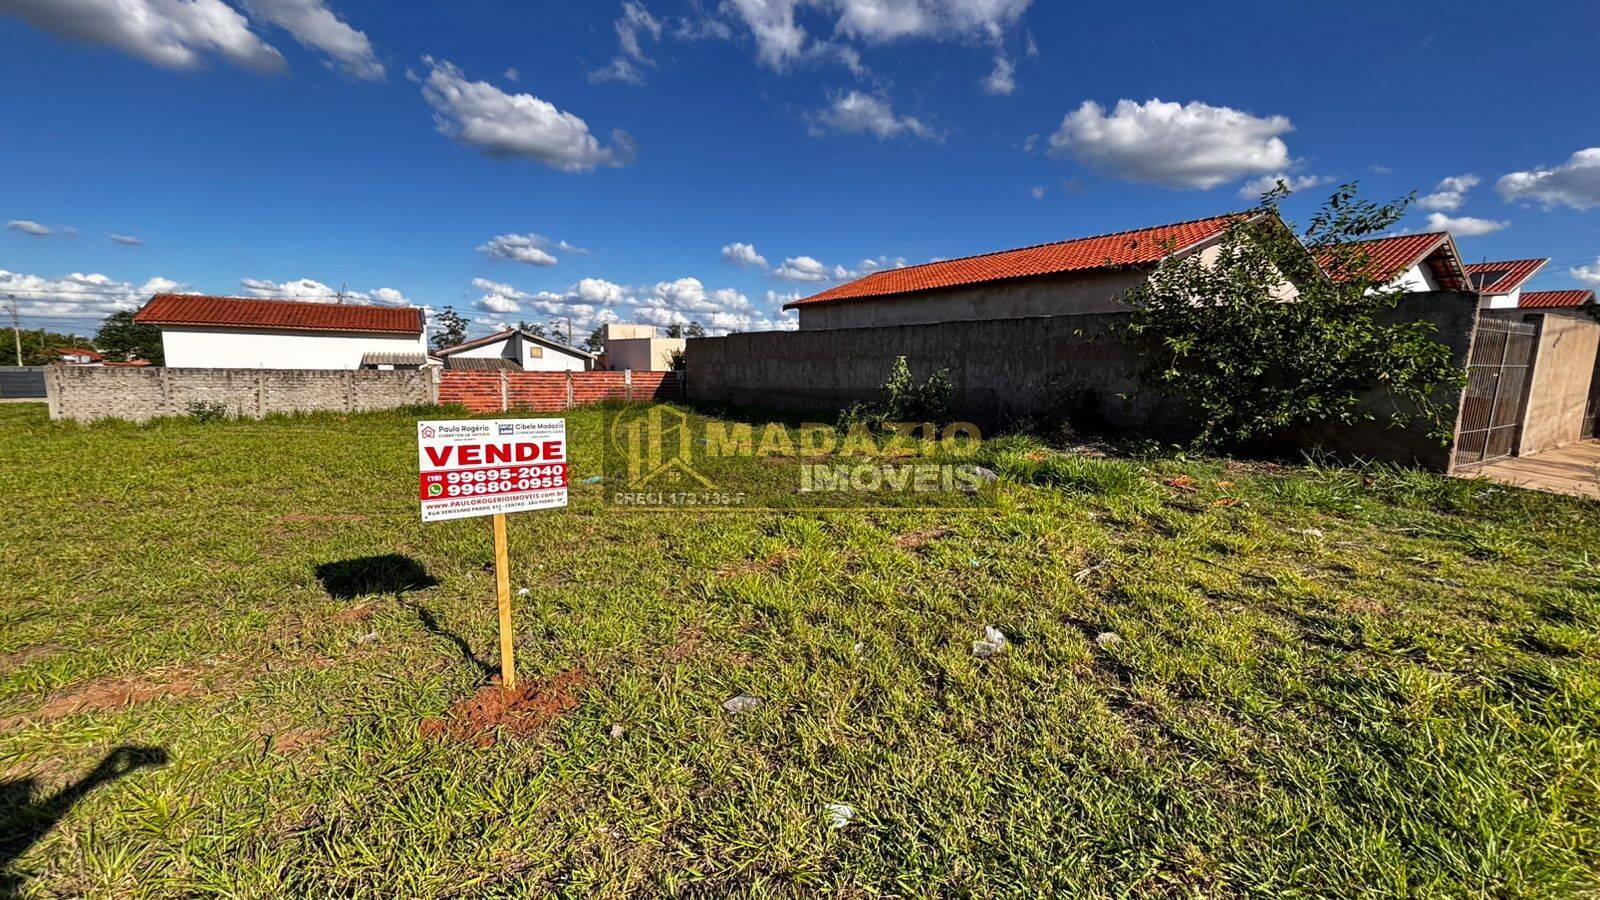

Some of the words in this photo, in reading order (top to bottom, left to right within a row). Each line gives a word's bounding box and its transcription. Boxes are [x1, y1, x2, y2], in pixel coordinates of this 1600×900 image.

[462, 424, 490, 433] Rogério
[424, 440, 563, 467] VENDE
[446, 464, 564, 484] 99695-2040
[446, 476, 564, 496] 99680-0955
[426, 490, 564, 510] www.PAULOROGERIOIMOVEIS.com.br
